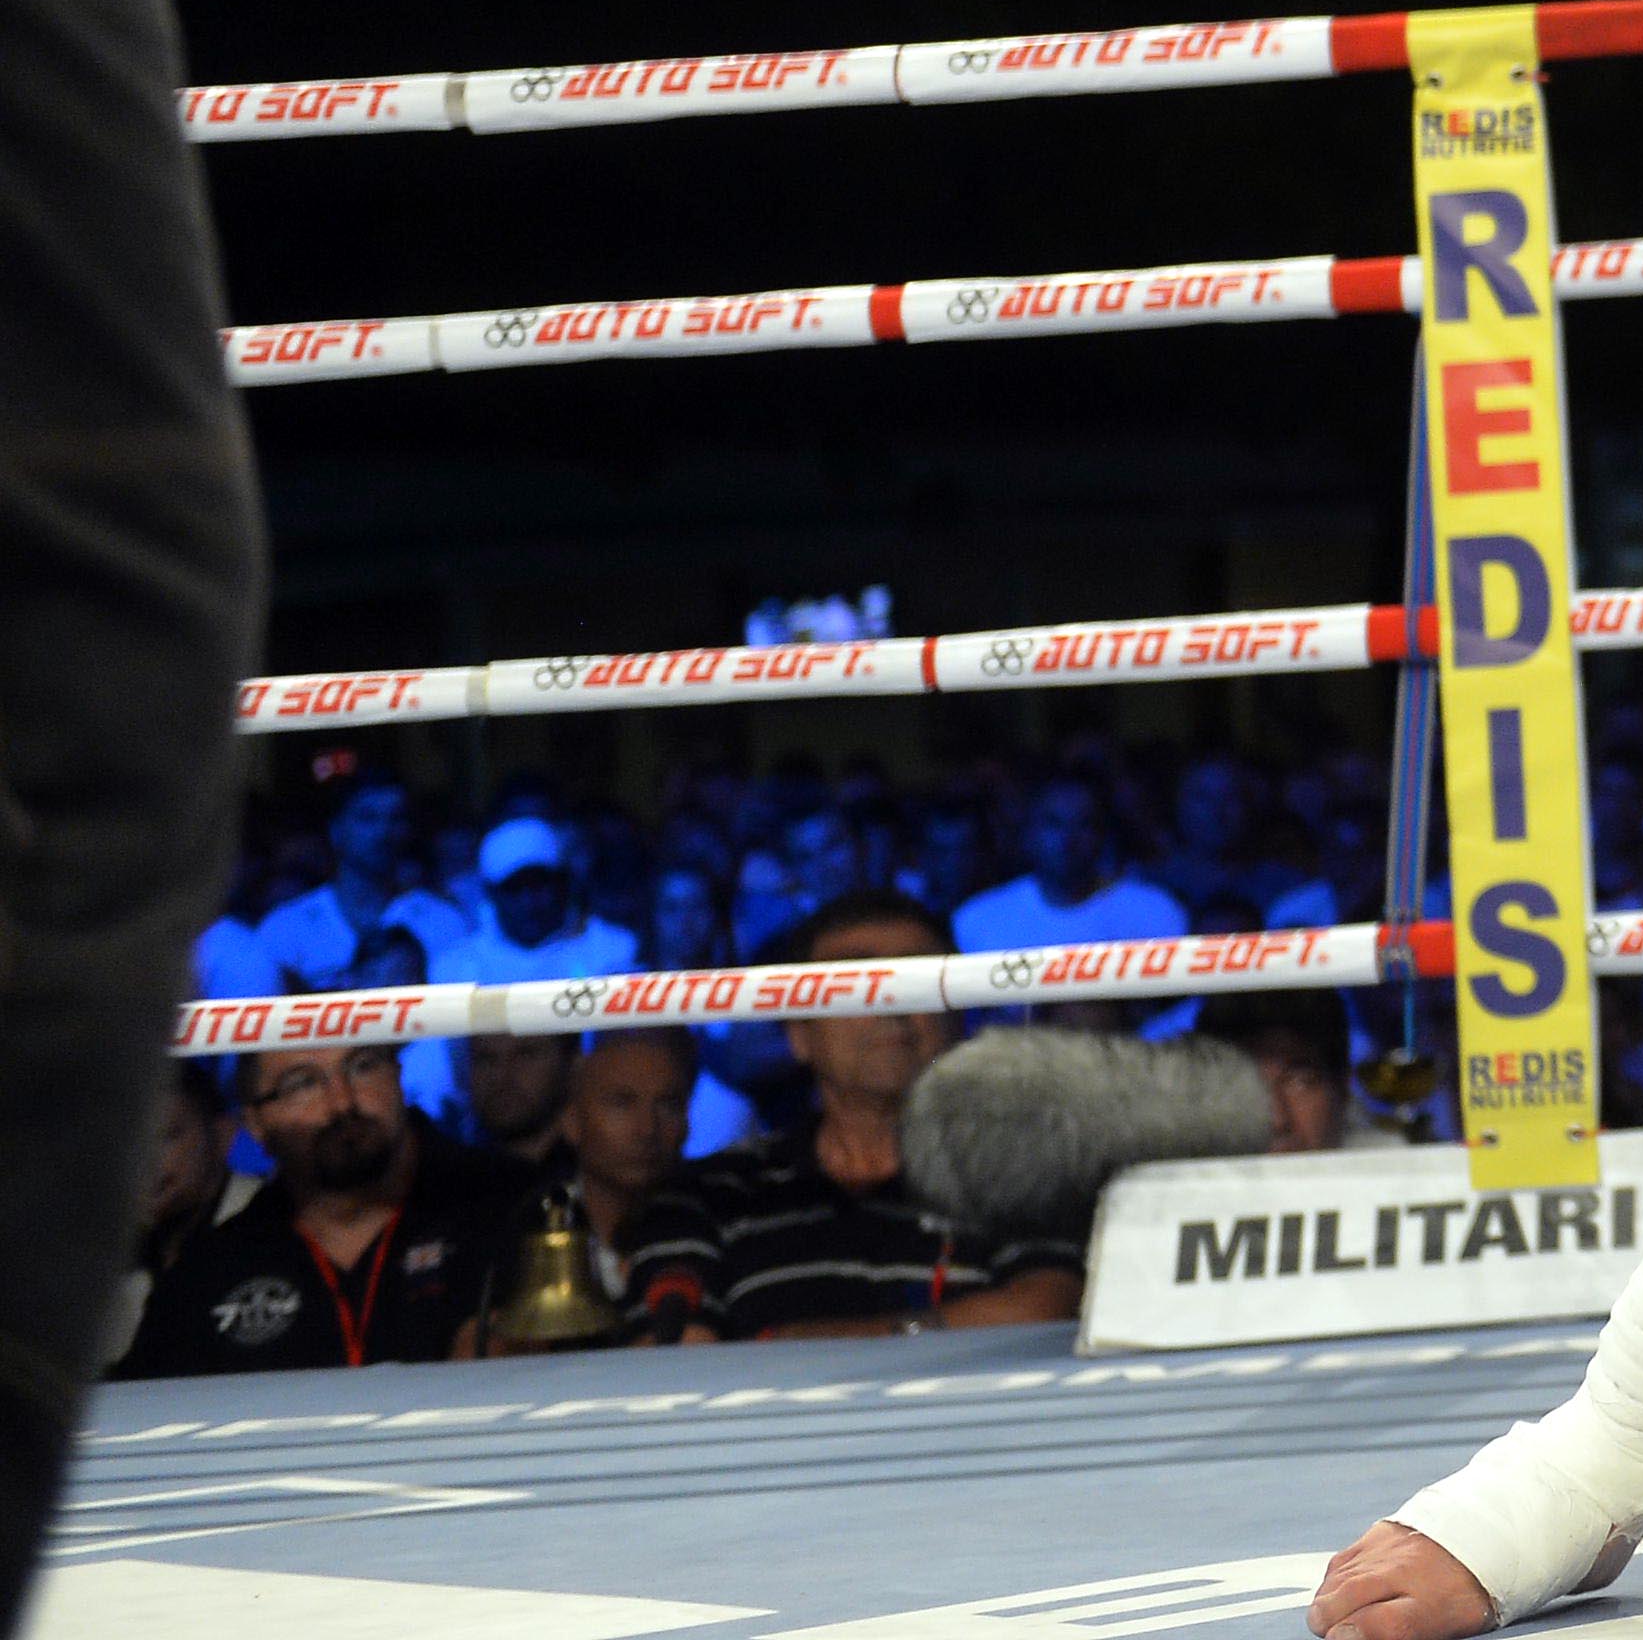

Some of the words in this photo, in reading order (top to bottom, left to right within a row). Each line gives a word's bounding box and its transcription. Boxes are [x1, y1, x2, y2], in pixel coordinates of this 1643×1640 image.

[998, 29, 1136, 72] AUTO
[1143, 19, 1286, 63] SOFT
[559, 57, 702, 102] AUTO
[709, 48, 848, 93] SOFT
[185, 88, 242, 124] TO
[255, 82, 394, 124] SOFT
[1421, 104, 1536, 139] REDIS
[1553, 243, 1627, 281] TO
[1000, 280, 1134, 320] AUTO
[1143, 268, 1283, 310] SOFT
[240, 321, 384, 362] SOFT
[534, 301, 672, 342] AUTO
[681, 296, 824, 336] SOFT
[584, 649, 726, 688] AUTO
[732, 644, 876, 681] SOFT
[1033, 629, 1171, 673] AUTO
[1179, 621, 1320, 665] SOFT
[277, 674, 424, 716] SOFT
[1040, 940, 1182, 985] AUTO
[1187, 931, 1328, 975] SOFT
[604, 972, 747, 1015] AUTO
[753, 970, 895, 1011] SOFT
[174, 1004, 272, 1047] UTO
[281, 995, 424, 1040] SOFT
[1469, 1047, 1586, 1091] REDIS
[1173, 1186, 1637, 1286] MILITARI
